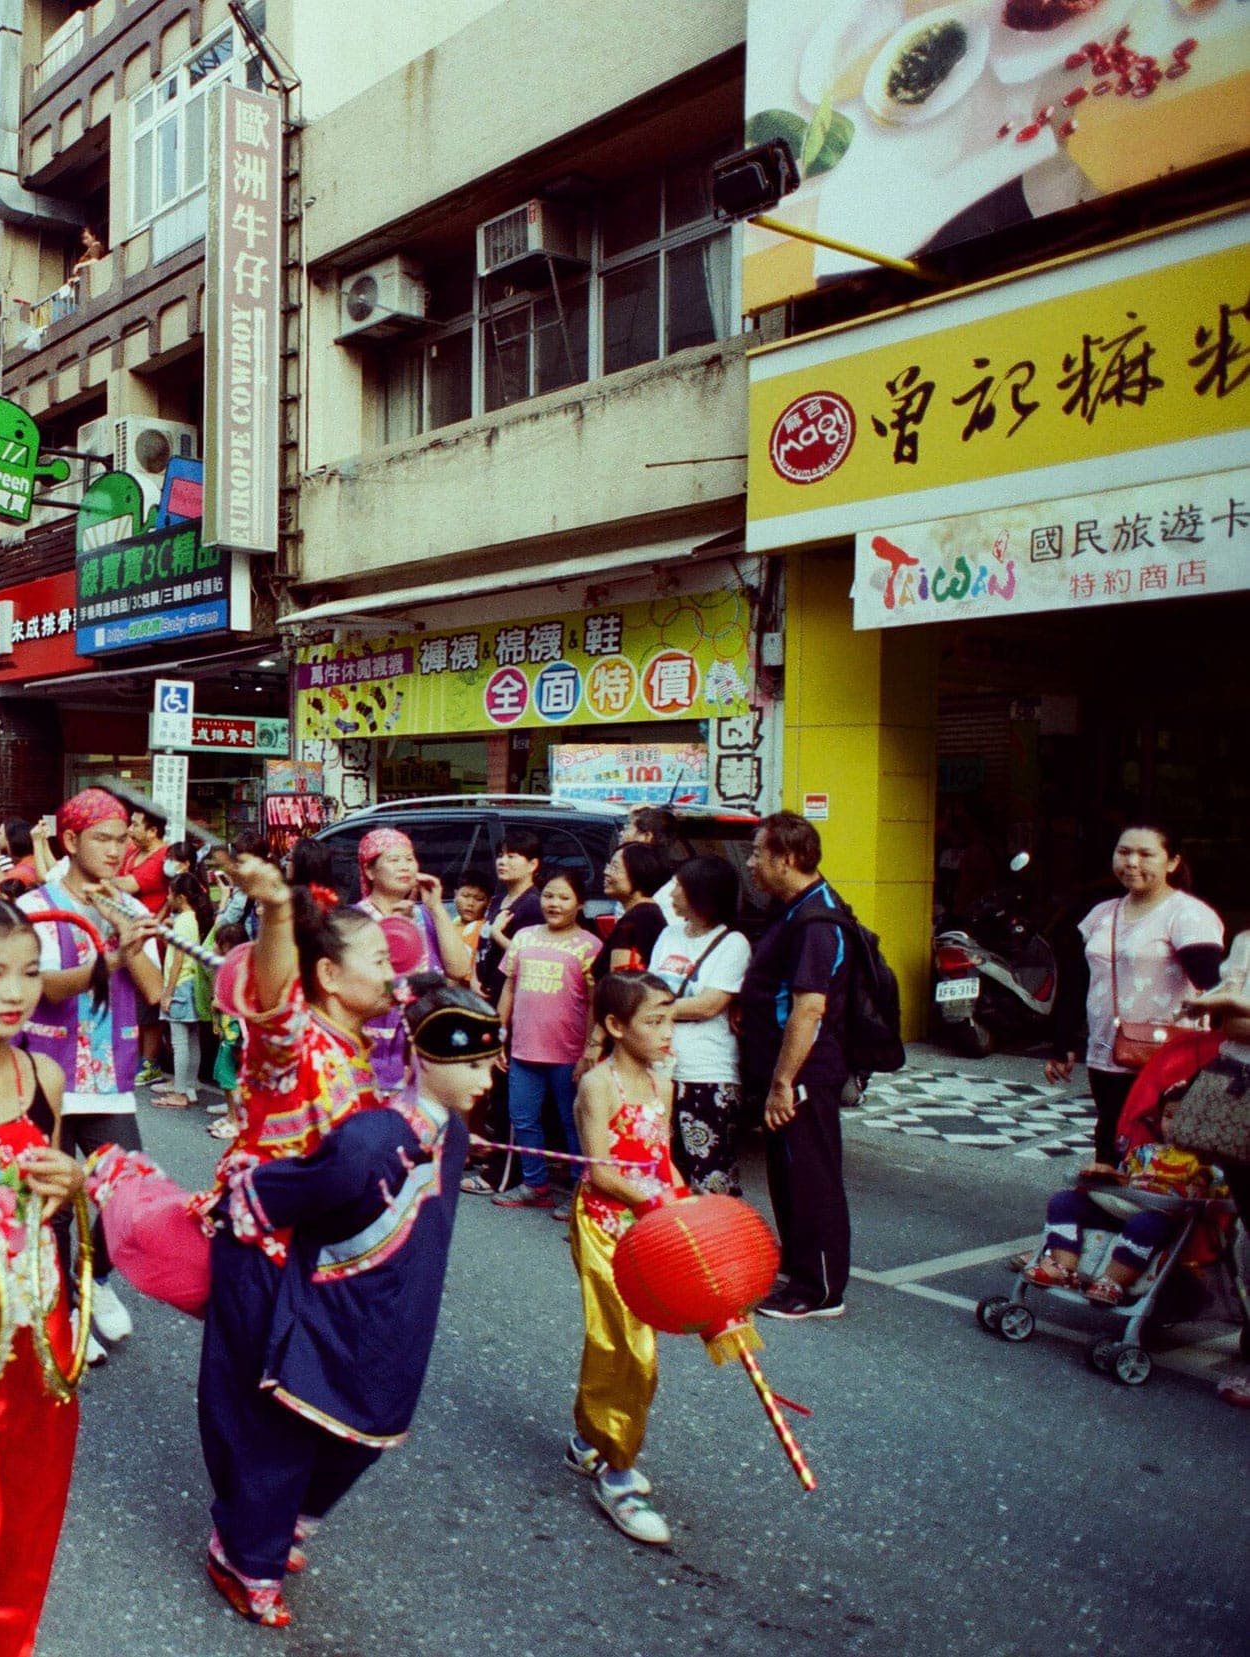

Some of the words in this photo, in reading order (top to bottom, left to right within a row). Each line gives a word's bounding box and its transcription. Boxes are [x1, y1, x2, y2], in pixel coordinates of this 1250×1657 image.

[231, 99, 270, 299] 歐洲牛仔
[230, 303, 252, 425] COWBOY
[230, 430, 252, 546] EUROPE
[1030, 498, 1249, 563] 國民旅遊卡
[1069, 559, 1208, 600] 特約商店
[11, 607, 77, 643] 來成排骨
[495, 622, 563, 667] 棉襪
[584, 612, 623, 658] 鞋
[490, 658, 694, 717] 全面特價
[625, 765, 662, 783] 100
